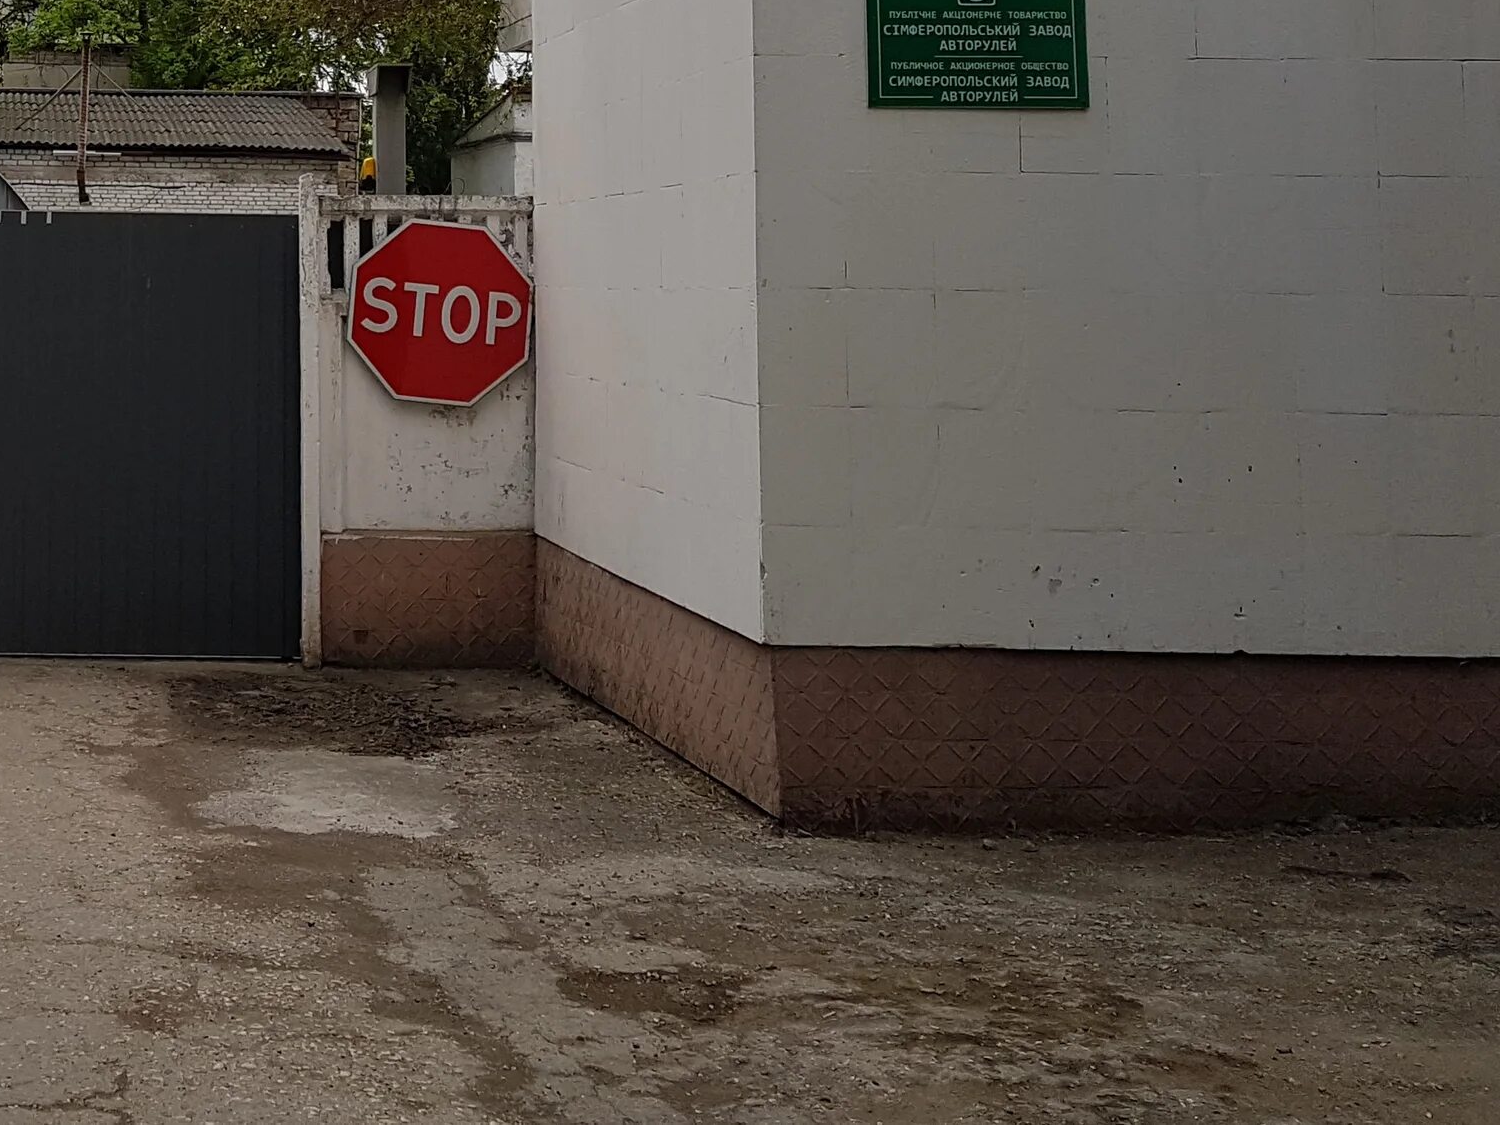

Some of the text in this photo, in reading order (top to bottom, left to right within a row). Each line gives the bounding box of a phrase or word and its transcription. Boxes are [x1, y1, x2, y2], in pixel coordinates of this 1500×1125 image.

[888, 10, 1067, 20] ПУБЛІЧНЕ АКЦІОНЕРНЕ ТОВАРИСТВО
[883, 22, 1072, 38] СІМФЕРОПОЛЬСЬКИЙ ЗАВОД
[939, 37, 1017, 51] АВТОРУЛЕЙ
[890, 61, 1069, 71] ПУБЛИЧНОЕ АКЦИОНЕРНОЕ ОБЩЕСТВО
[888, 73, 1070, 89] СИМФЕРОПОЛЬСКИЙ ЗАВОД
[940, 88, 1019, 102] АВТОРУЛЕЙ
[360, 277, 522, 345] STOP
